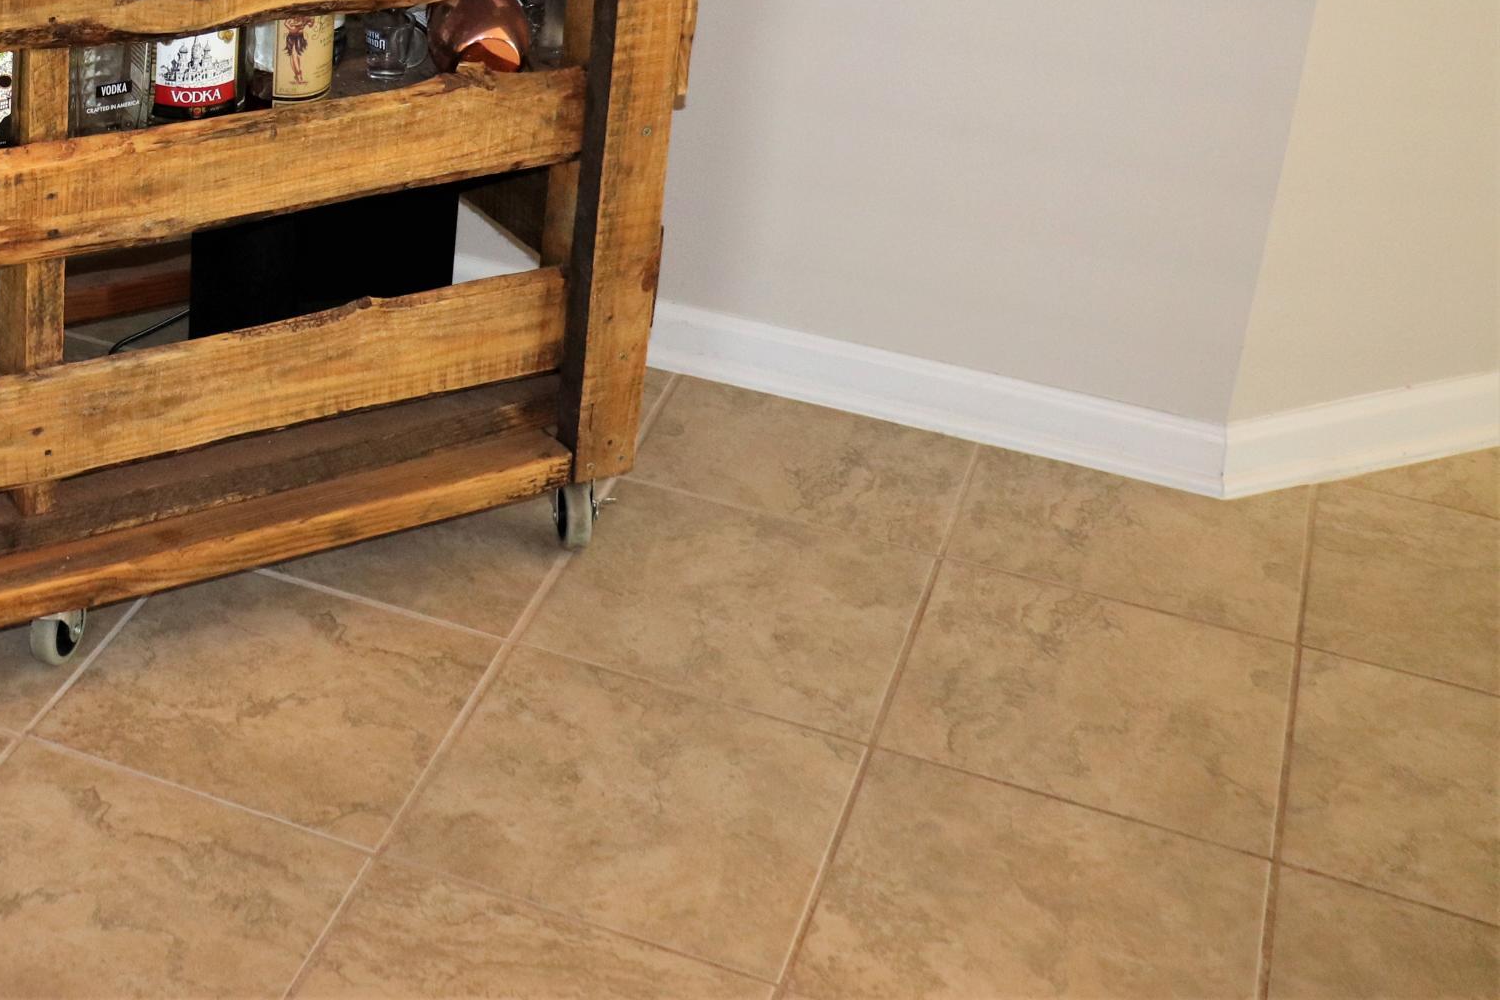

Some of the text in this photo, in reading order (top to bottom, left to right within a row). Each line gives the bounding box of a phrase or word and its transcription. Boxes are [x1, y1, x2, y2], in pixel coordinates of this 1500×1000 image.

[101, 82, 128, 97] VODKA
[171, 88, 222, 104] VODKA
[86, 104, 110, 115] CRAFTED
[116, 100, 141, 110] AMERICA
